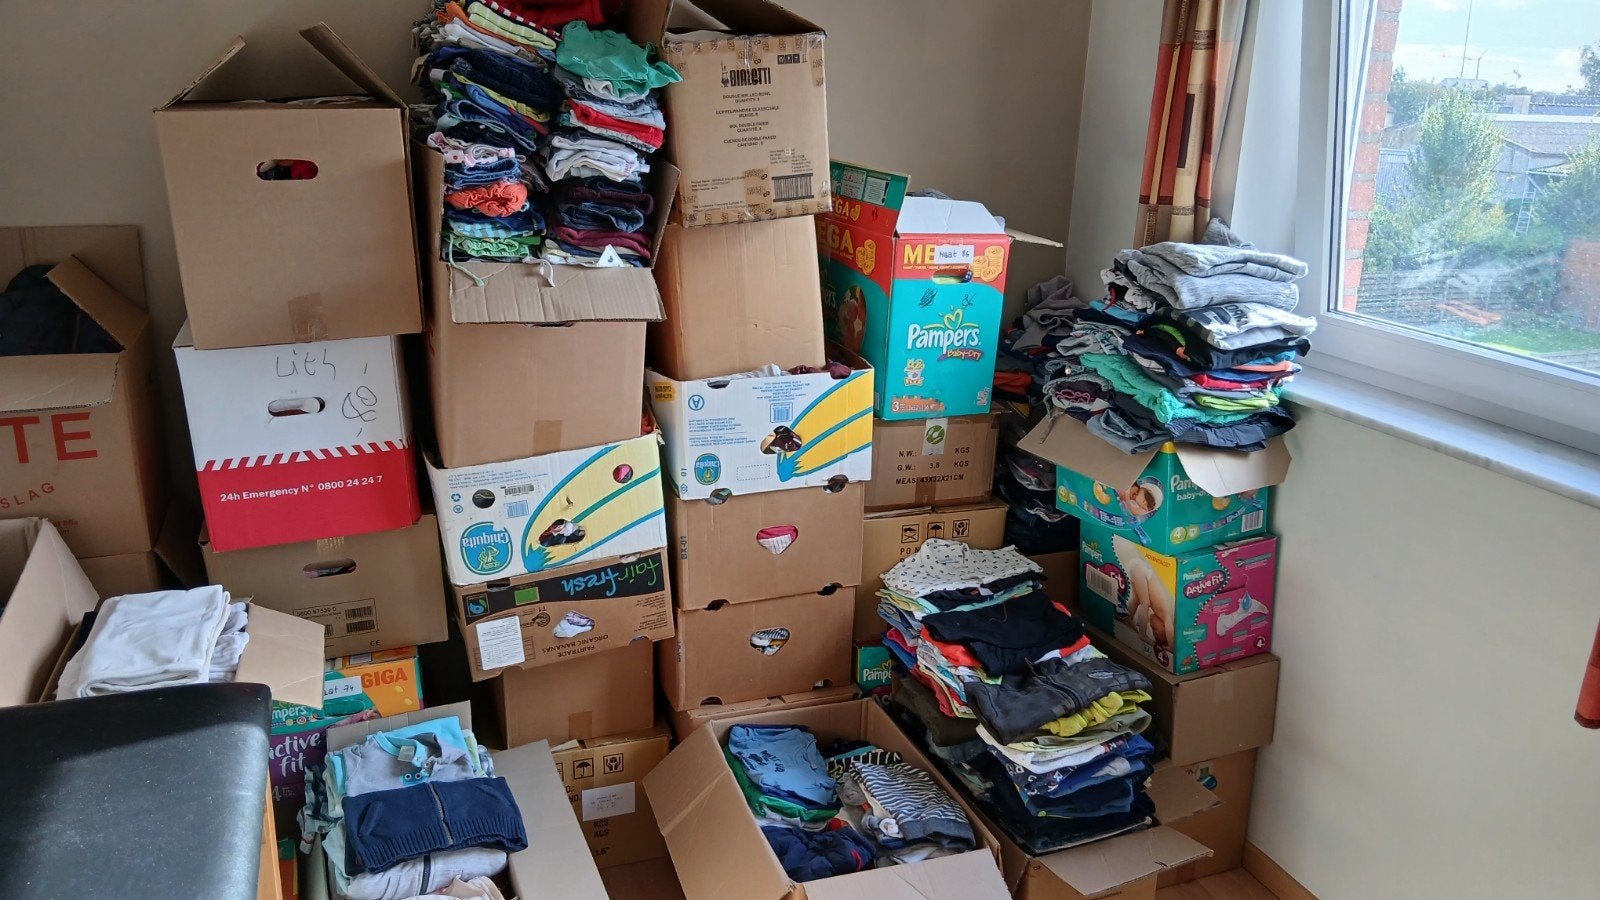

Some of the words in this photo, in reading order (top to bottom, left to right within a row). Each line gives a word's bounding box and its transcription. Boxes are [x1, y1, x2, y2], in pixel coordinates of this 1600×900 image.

[904, 244, 935, 264] ME
[907, 324, 980, 354] Pampers
[954, 446, 970, 454] KGS
[220, 492, 241, 502] 24h
[243, 486, 299, 500] Emergency
[318, 480, 344, 491] 0800
[346, 478, 360, 487] 24
[361, 476, 375, 486] 24
[377, 475, 383, 483] 7
[462, 531, 510, 548] Chiquita
[541, 640, 578, 654] BANANAS
[579, 634, 609, 648] ORGANIC
[557, 644, 595, 658] FAIRTRADE
[361, 667, 408, 689] GIGA
[271, 705, 308, 721] mpers
[280, 752, 306, 777] fit
